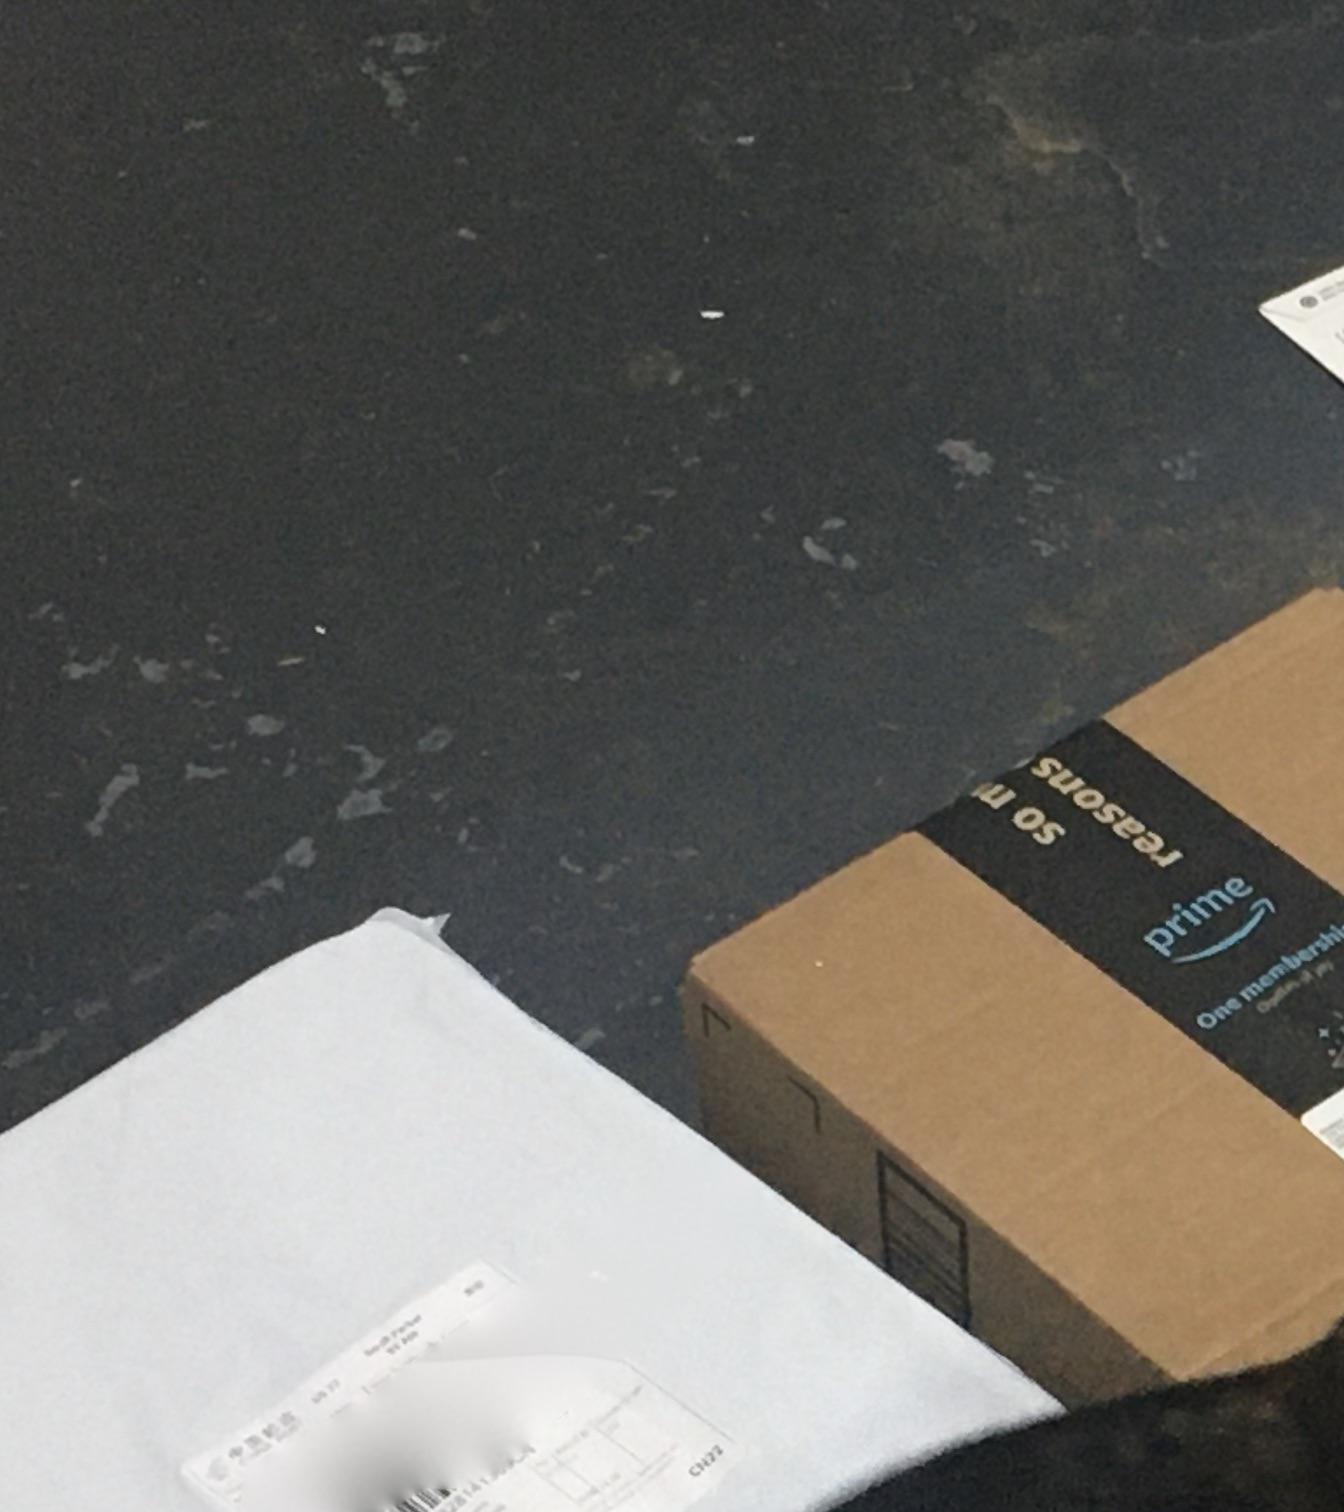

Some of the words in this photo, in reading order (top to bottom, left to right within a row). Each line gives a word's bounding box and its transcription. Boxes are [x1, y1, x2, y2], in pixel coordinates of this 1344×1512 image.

[1012, 806, 1067, 846] so
[1030, 757, 1185, 868] reasons
[1143, 876, 1254, 958] prime
[1196, 997, 1243, 1029] One
